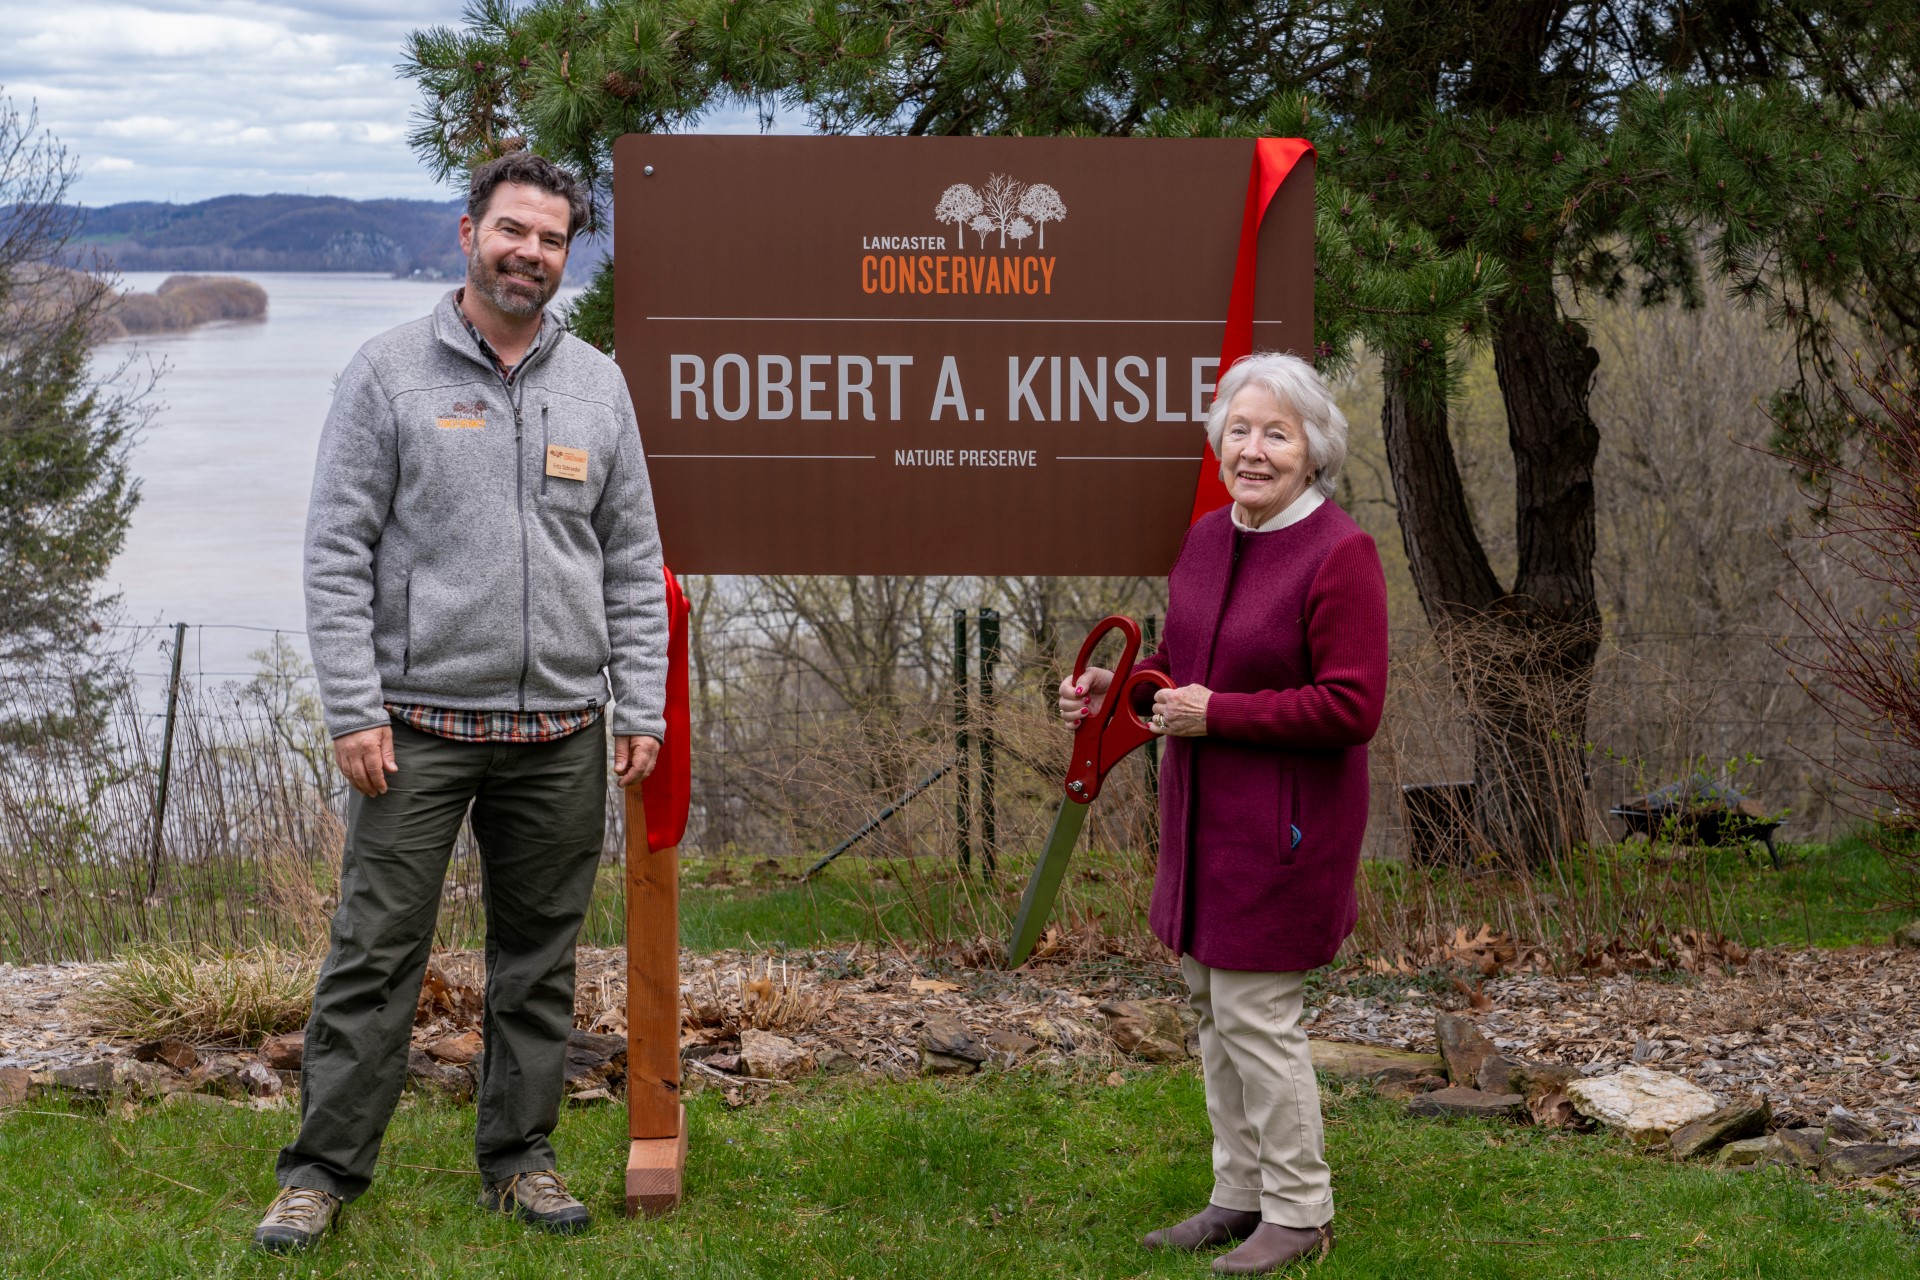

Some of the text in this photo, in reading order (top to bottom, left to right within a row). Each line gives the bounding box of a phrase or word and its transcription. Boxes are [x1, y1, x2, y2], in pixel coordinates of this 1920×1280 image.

[863, 236, 946, 250] LANCASTER
[862, 255, 1056, 295] CONSERVANCY
[670, 353, 1222, 423] ROBERT A. KINSLE
[895, 449, 1037, 467] NATURE PRESERVE
